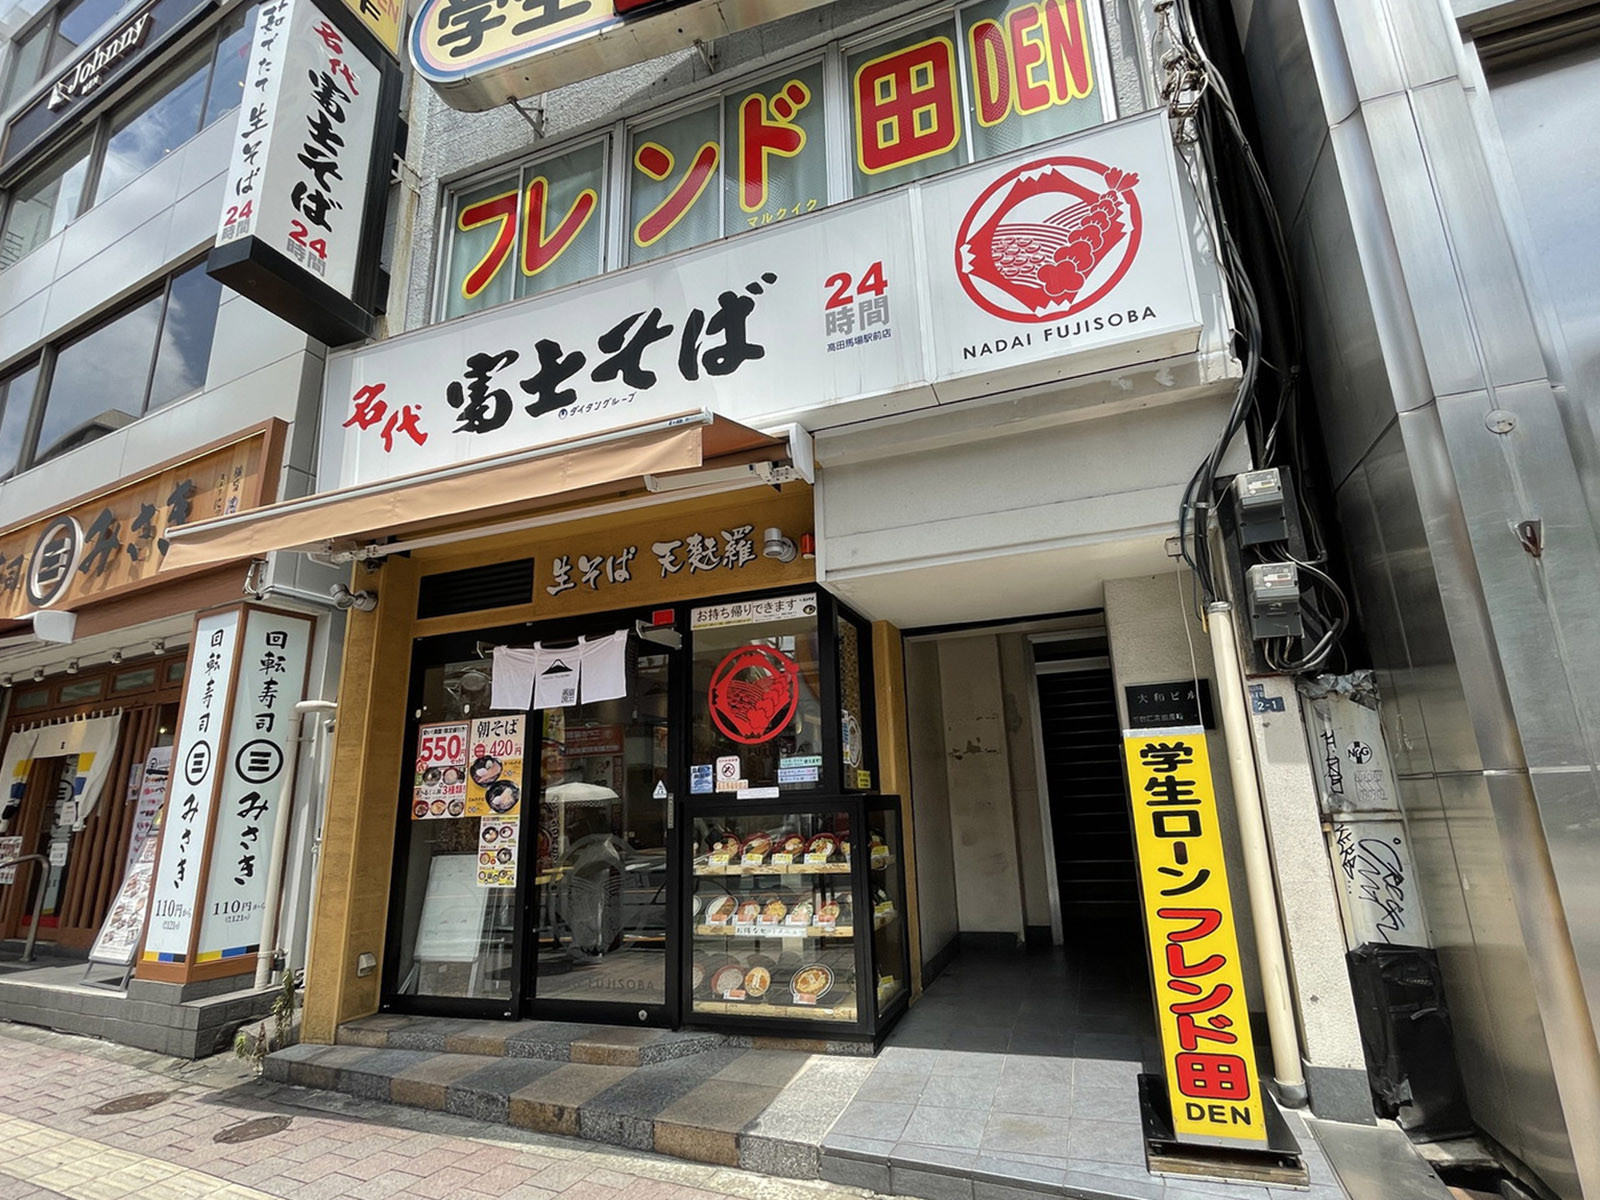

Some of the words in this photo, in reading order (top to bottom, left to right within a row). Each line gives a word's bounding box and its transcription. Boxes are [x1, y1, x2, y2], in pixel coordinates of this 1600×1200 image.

[68, 12, 150, 94] Johnny
[313, 21, 359, 95] 名代
[458, 36, 962, 299] フレンド田
[968, 0, 1094, 128] DEN
[221, 220, 250, 241] 時間
[224, 200, 253, 227] 24
[286, 238, 326, 277] 時間
[288, 219, 327, 260] 24
[824, 261, 888, 311] 24
[825, 295, 889, 337] 時間
[827, 328, 891, 352] 高田馬場駅前店
[963, 333, 1031, 360] NADAI
[1044, 306, 1157, 340] FUJISOBA
[342, 383, 428, 453] 名代
[570, 391, 638, 416] ダイタングループ
[0, 552, 25, 592] 司
[546, 546, 637, 596] 生そば
[696, 599, 797, 622] お持ち帰りできます
[198, 629, 224, 733] 回転寿司
[254, 630, 288, 733] 回転寿司
[1257, 700, 1277, 711] 2-1
[477, 719, 520, 738] 朝そば
[174, 793, 199, 889] みさき
[234, 791, 269, 886] みさき
[1139, 741, 1210, 896] 学生ローン
[1157, 908, 1250, 1101] フレンド田
[1186, 1102, 1251, 1126] DEN
